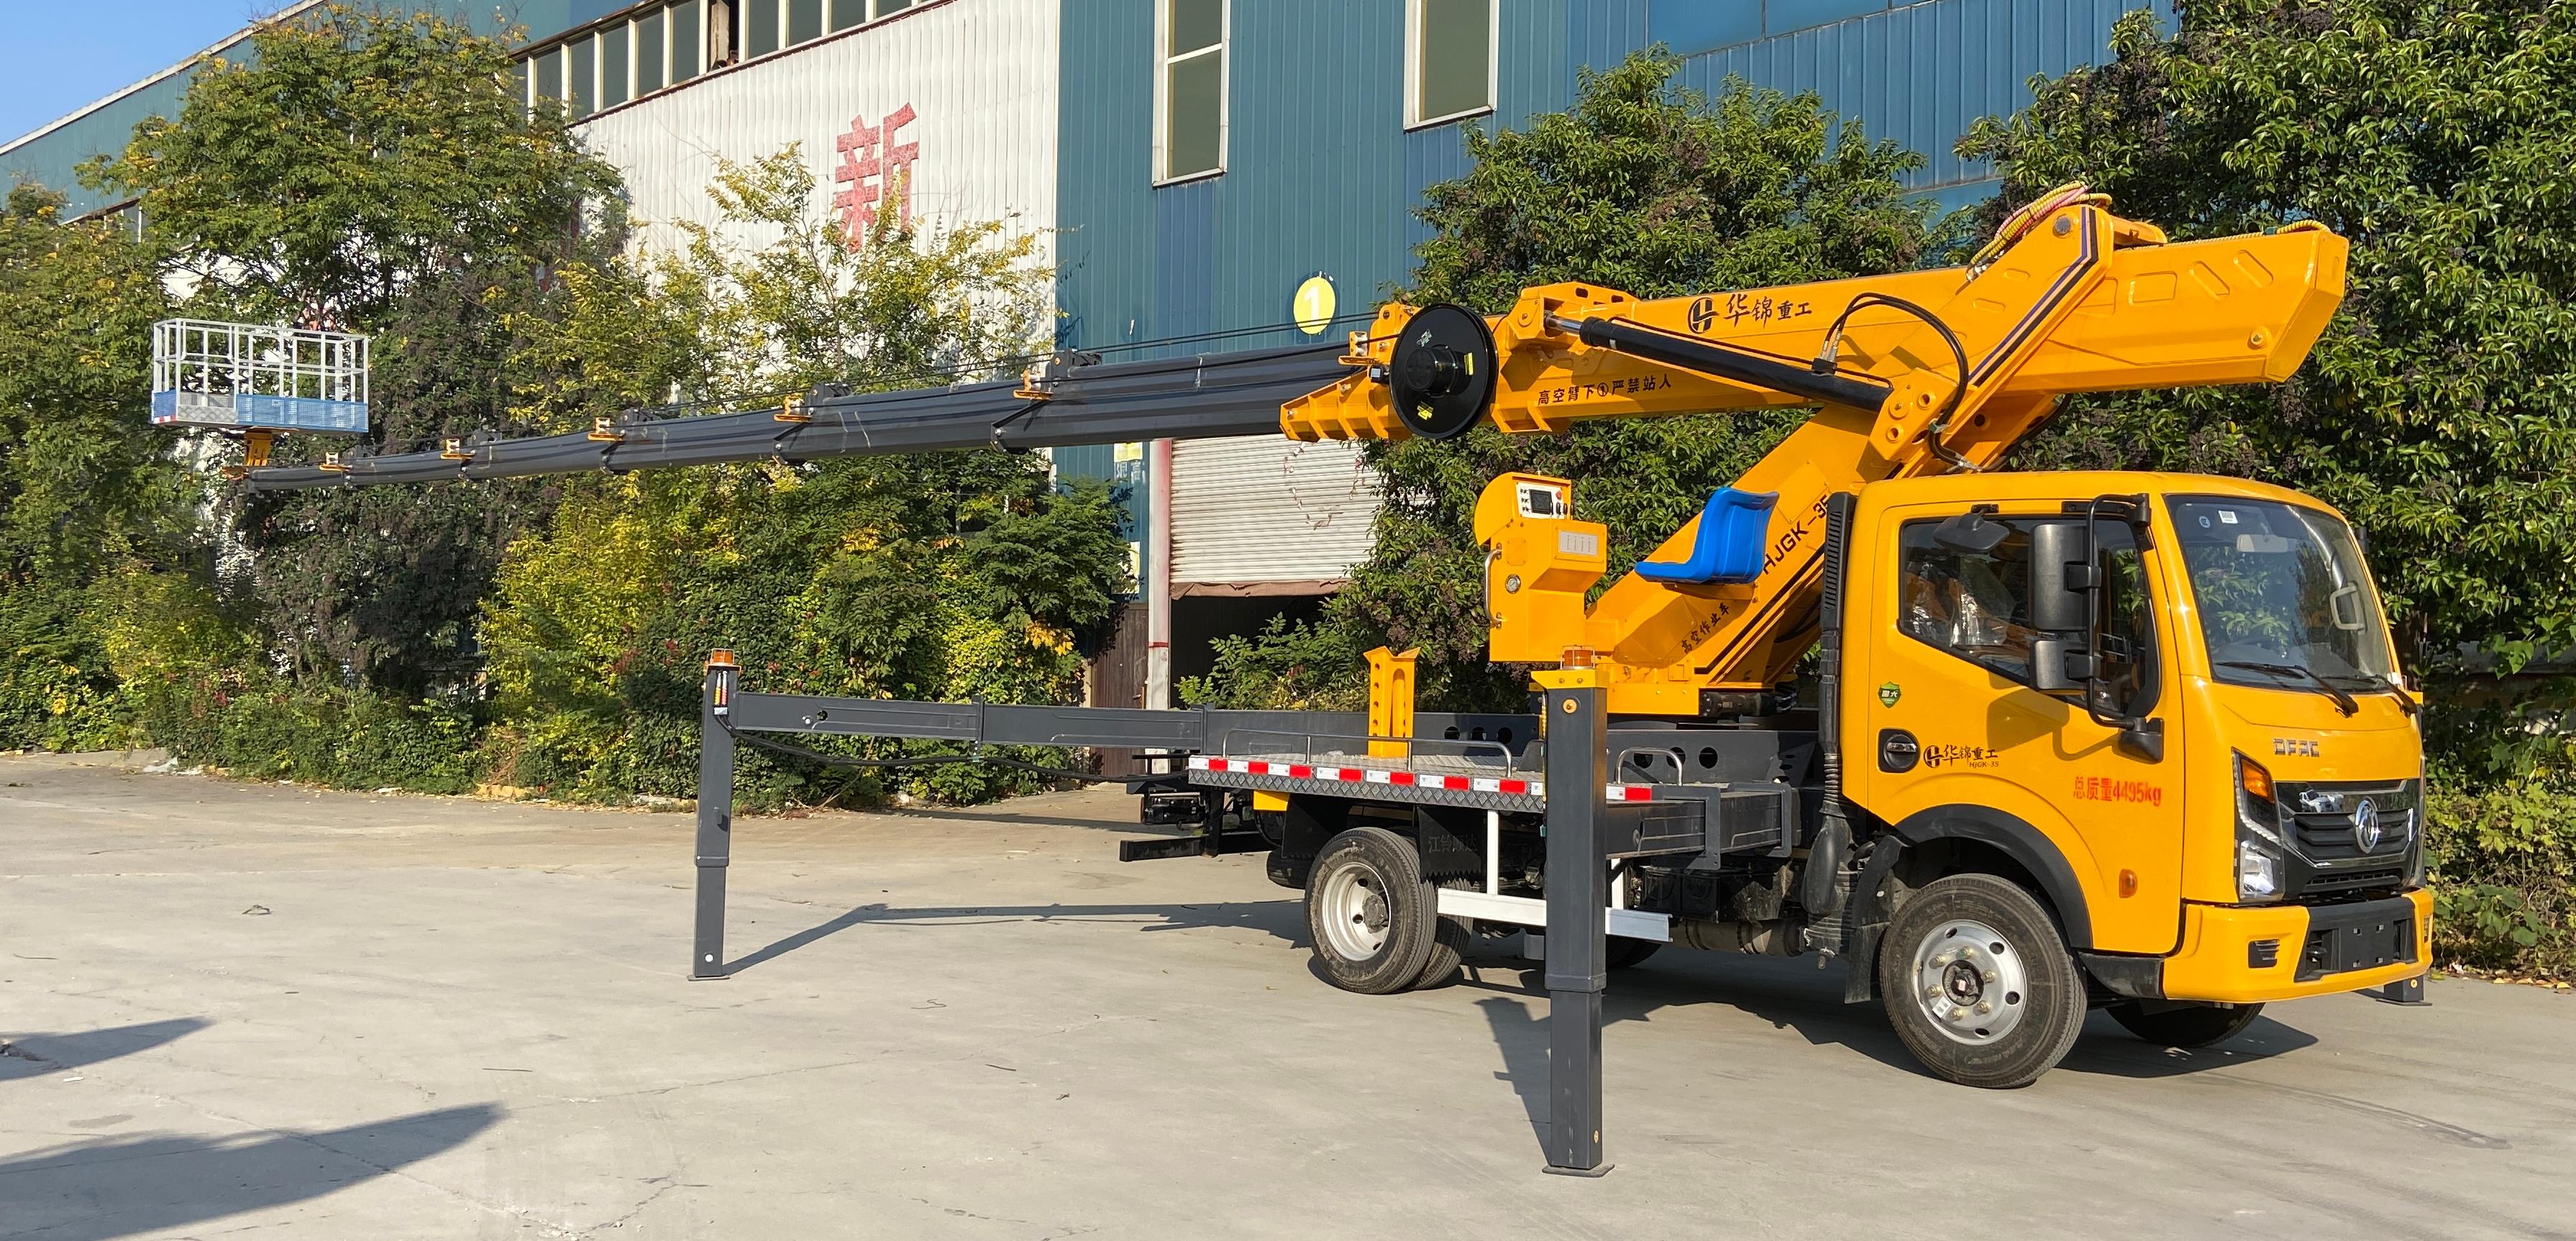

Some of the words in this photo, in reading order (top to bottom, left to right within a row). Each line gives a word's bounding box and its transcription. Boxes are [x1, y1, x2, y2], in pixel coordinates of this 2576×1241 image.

[835, 101, 919, 255] 新
[1304, 286, 1320, 326] 1
[1724, 293, 1812, 328] 华锦重工
[1538, 384, 1594, 406] 高空臂下
[1612, 373, 1672, 395] 严禁站人
[1942, 743, 1998, 766] 华锦重工
